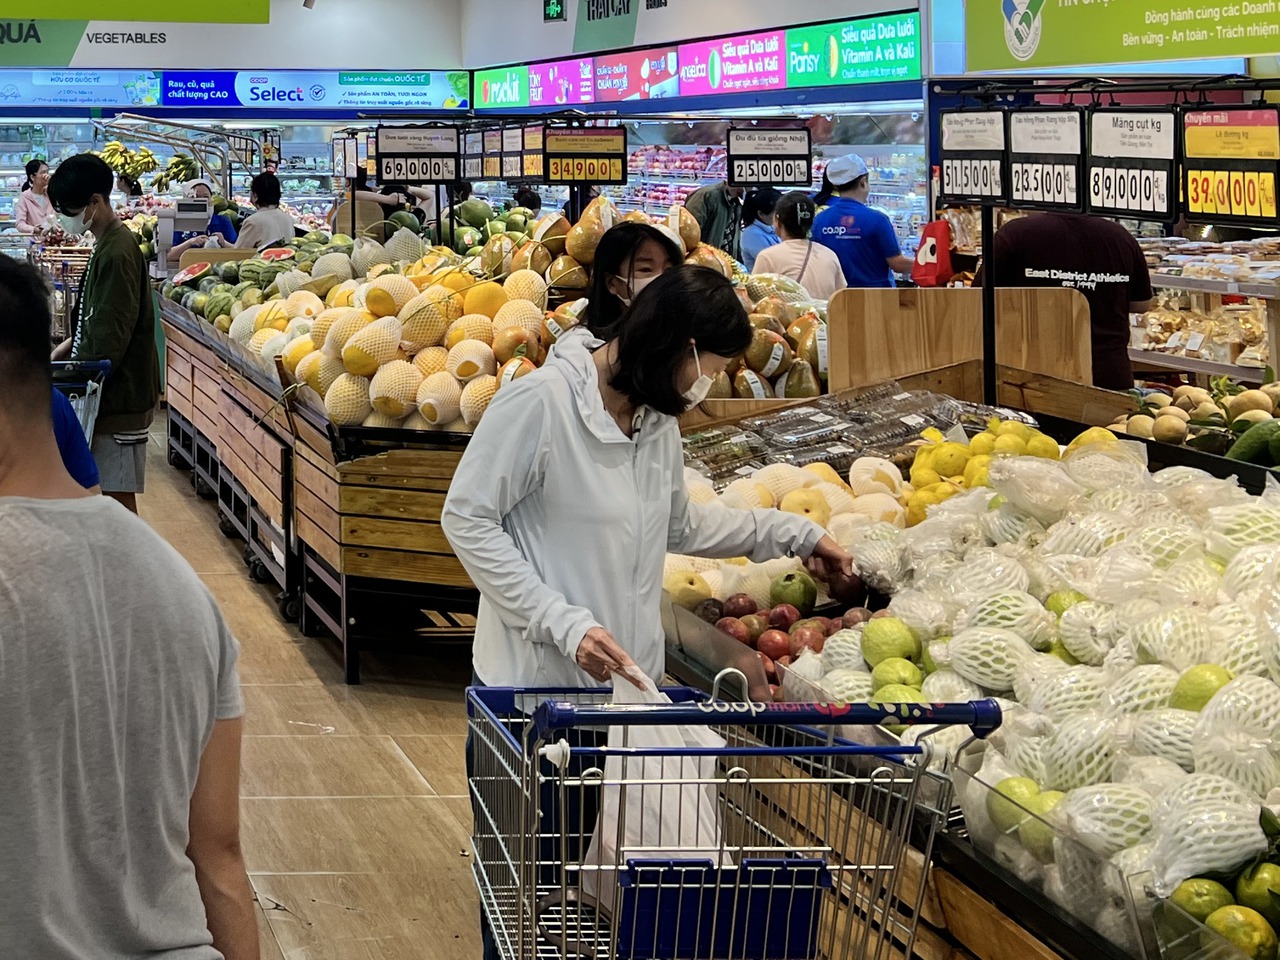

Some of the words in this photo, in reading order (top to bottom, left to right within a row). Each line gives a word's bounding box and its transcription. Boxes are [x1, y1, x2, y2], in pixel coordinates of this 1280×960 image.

[1145, 10, 1168, 26] Đồng
[1171, 8, 1193, 20] hành
[1196, 6, 1220, 20] cùng
[1222, 3, 1239, 16] các
[1242, 0, 1275, 14] Doanh
[86, 33, 167, 44] VEGETABLES
[842, 26, 859, 44] Siêu
[861, 25, 877, 42] quả
[878, 23, 895, 39] Dưa
[1123, 32, 1140, 46] Bền
[1141, 32, 1163, 46] vững
[1172, 30, 1184, 42] An
[1186, 28, 1207, 41] toàn
[1216, 25, 1244, 39] Trách
[1247, 22, 1278, 38] nhiệm
[842, 47, 874, 64] Vitamin
[875, 50, 883, 61] A
[885, 47, 895, 61] và
[897, 42, 914, 59] Kali
[722, 59, 748, 75] Vitamin
[748, 59, 754, 73] A
[764, 56, 778, 71] Kali
[168, 80, 185, 90] Rau,
[200, 80, 215, 90] quả
[491, 72, 519, 104] rockit
[168, 88, 184, 99] chất
[186, 89, 208, 101] lượng
[210, 90, 228, 99] CAO
[250, 86, 304, 102] Select
[1112, 116, 1134, 132] Măng
[1136, 119, 1149, 132] cụt
[1151, 118, 1161, 132] kg
[1185, 112, 1212, 125] Khuyến
[1213, 112, 1228, 123] mãi
[385, 161, 441, 176] 69.000
[552, 162, 608, 176] 34.900
[737, 163, 793, 177] 25.000
[946, 165, 988, 188] 51.500
[1014, 169, 1062, 195] 23.500
[1092, 172, 1151, 200] 89.000
[1191, 177, 1257, 207] 39.000
[1025, 268, 1050, 278] East
[1051, 270, 1087, 281] District
[1089, 273, 1129, 282] Athletics
